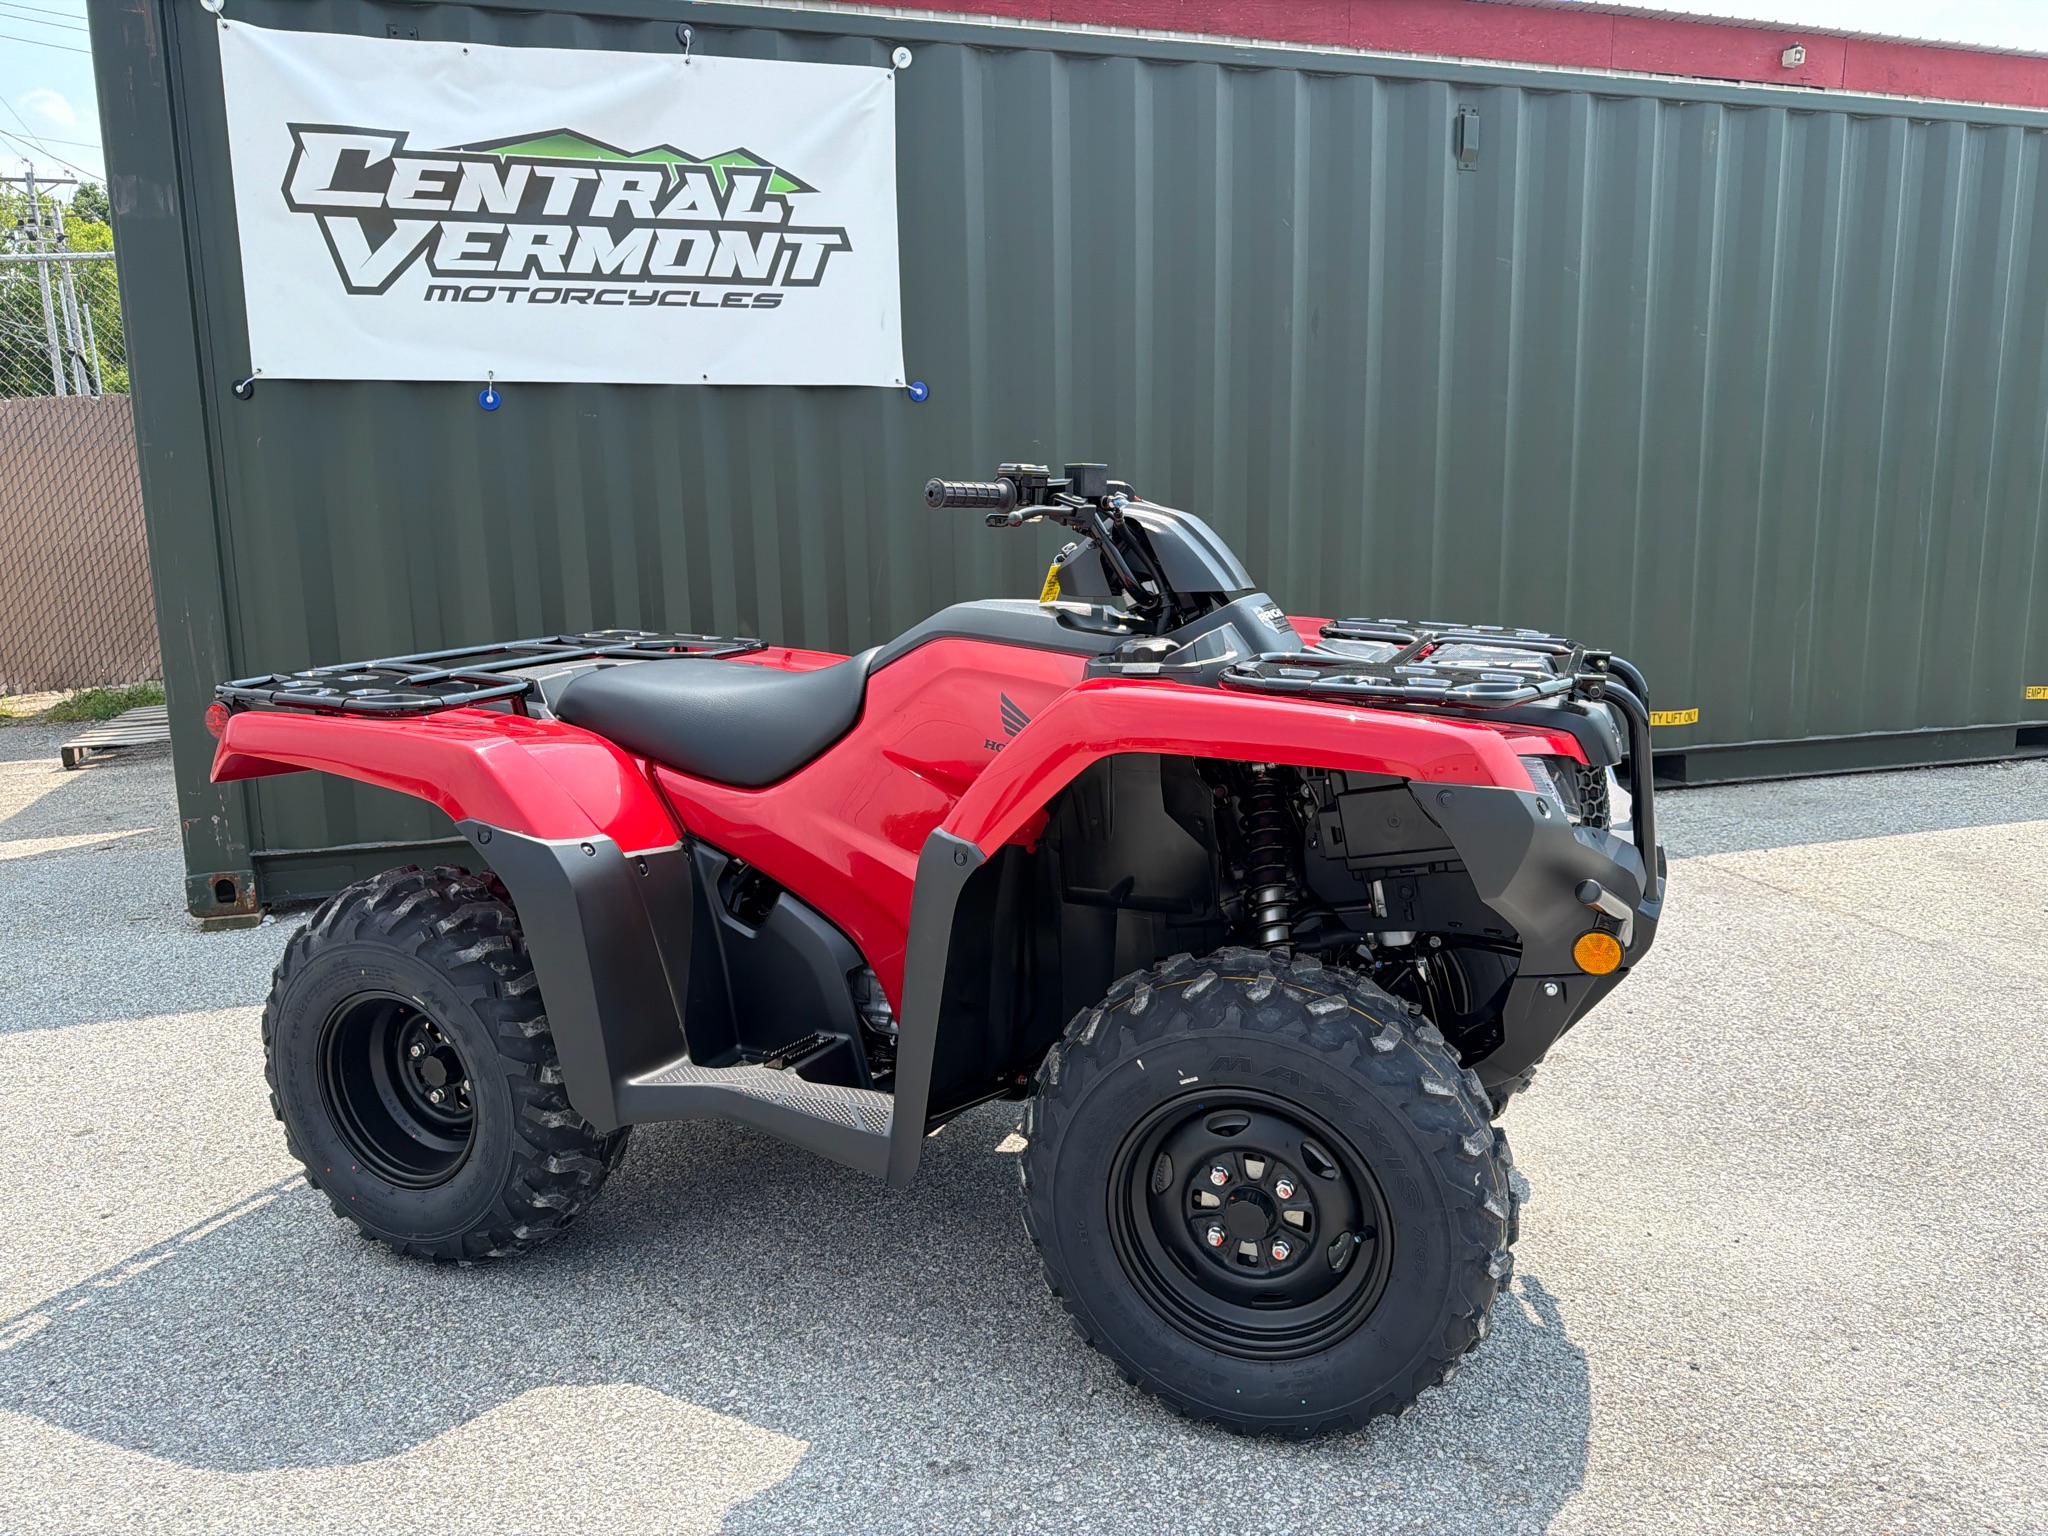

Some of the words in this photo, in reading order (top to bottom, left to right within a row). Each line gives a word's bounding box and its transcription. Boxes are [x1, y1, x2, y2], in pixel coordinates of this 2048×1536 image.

[286, 126, 790, 224] CENTRAL
[318, 213, 848, 291] VERMONT
[423, 284, 784, 309] MOTORCYCLES
[1665, 712, 1682, 724] LIFT
[1208, 1055, 1423, 1210] MAXXIS
